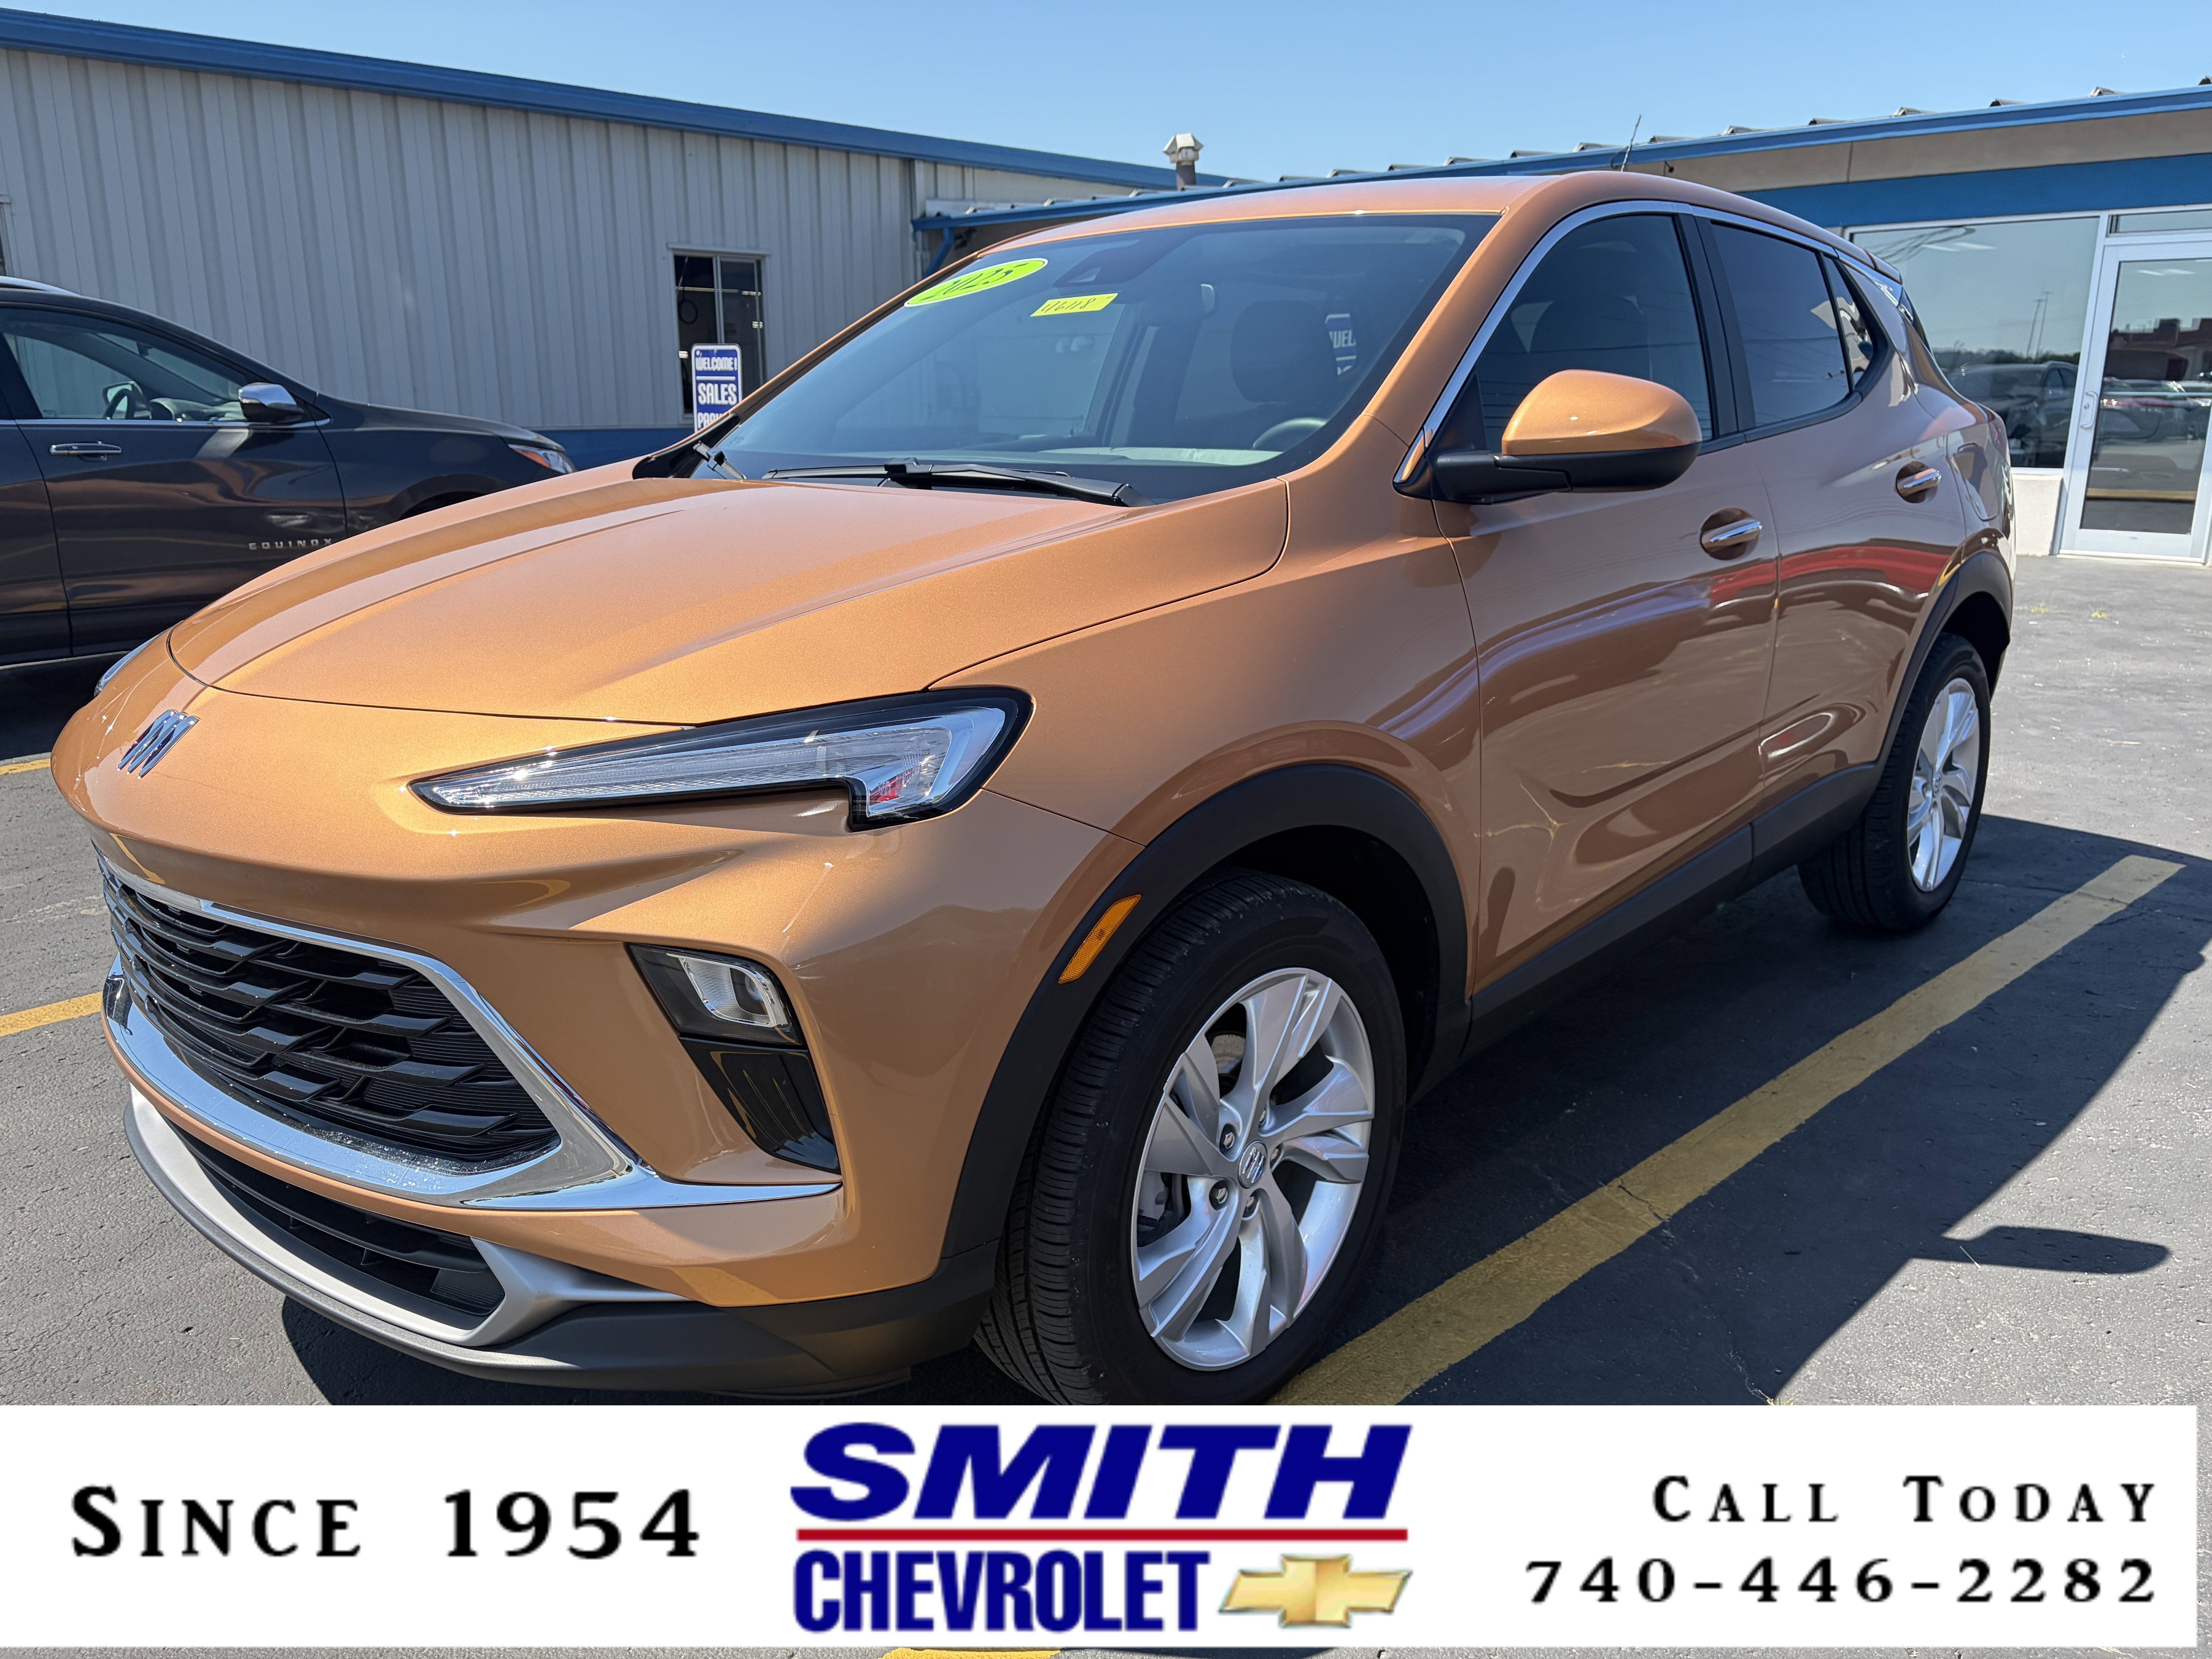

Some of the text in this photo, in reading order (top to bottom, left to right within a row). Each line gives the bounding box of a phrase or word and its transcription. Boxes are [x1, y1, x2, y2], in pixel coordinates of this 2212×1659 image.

[919, 262, 1029, 301] 2025
[696, 357, 738, 371] WELCOME!
[698, 383, 737, 405] SALES
[697, 412, 723, 429] PAR
[249, 538, 331, 550] EQUINOX
